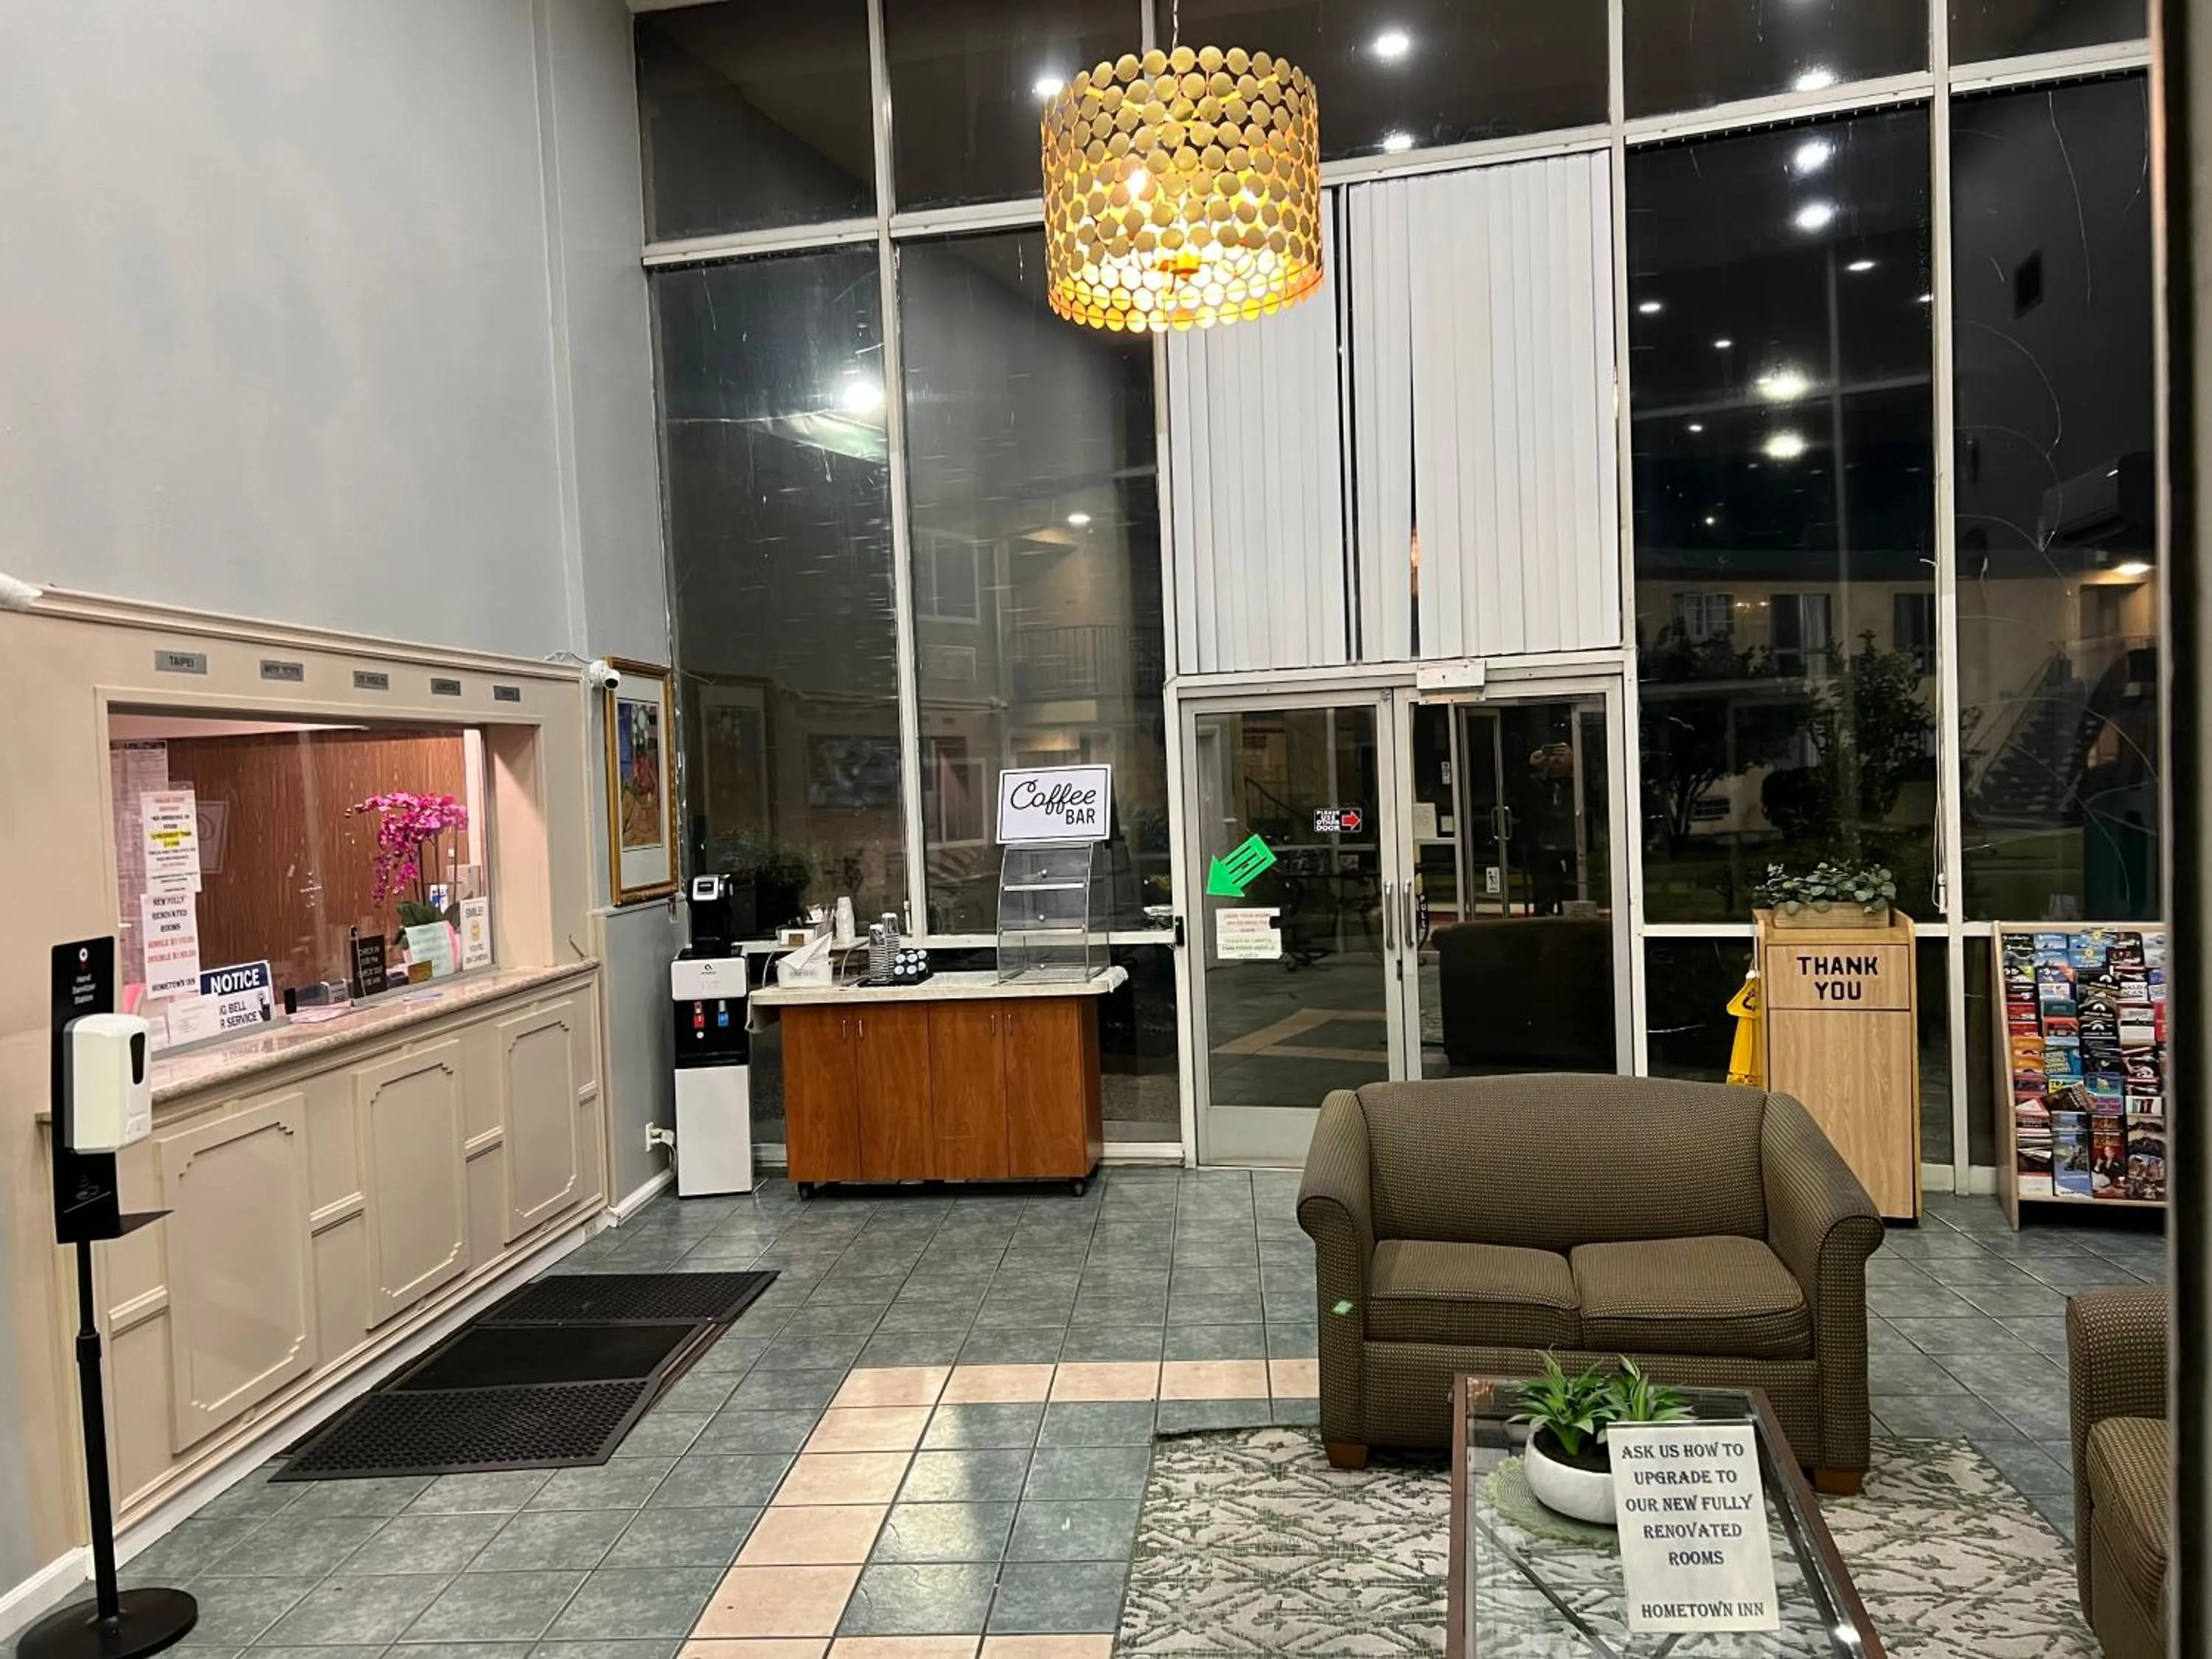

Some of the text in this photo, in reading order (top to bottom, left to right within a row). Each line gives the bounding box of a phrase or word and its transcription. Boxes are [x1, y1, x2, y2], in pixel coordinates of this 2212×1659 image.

[169, 655, 194, 667] TAIPEI
[1010, 779, 1096, 815] Coffee
[1065, 808, 1096, 824] BAR
[1796, 956, 1878, 975] THANK
[210, 968, 260, 995] NOTICE
[1815, 981, 1862, 1000] YOU
[229, 1001, 247, 1013] BELL
[227, 1012, 258, 1028] SERVICE
[1622, 1441, 1745, 1459] ASK US HOW TO
[1634, 1470, 1738, 1485] UPGRADE TO
[1625, 1494, 1753, 1512] OUR NEW FULLY
[1644, 1522, 1742, 1539] RENOVATED
[1669, 1551, 1725, 1566] ROOMS
[1641, 1601, 1764, 1618] HOMETOWN INN
